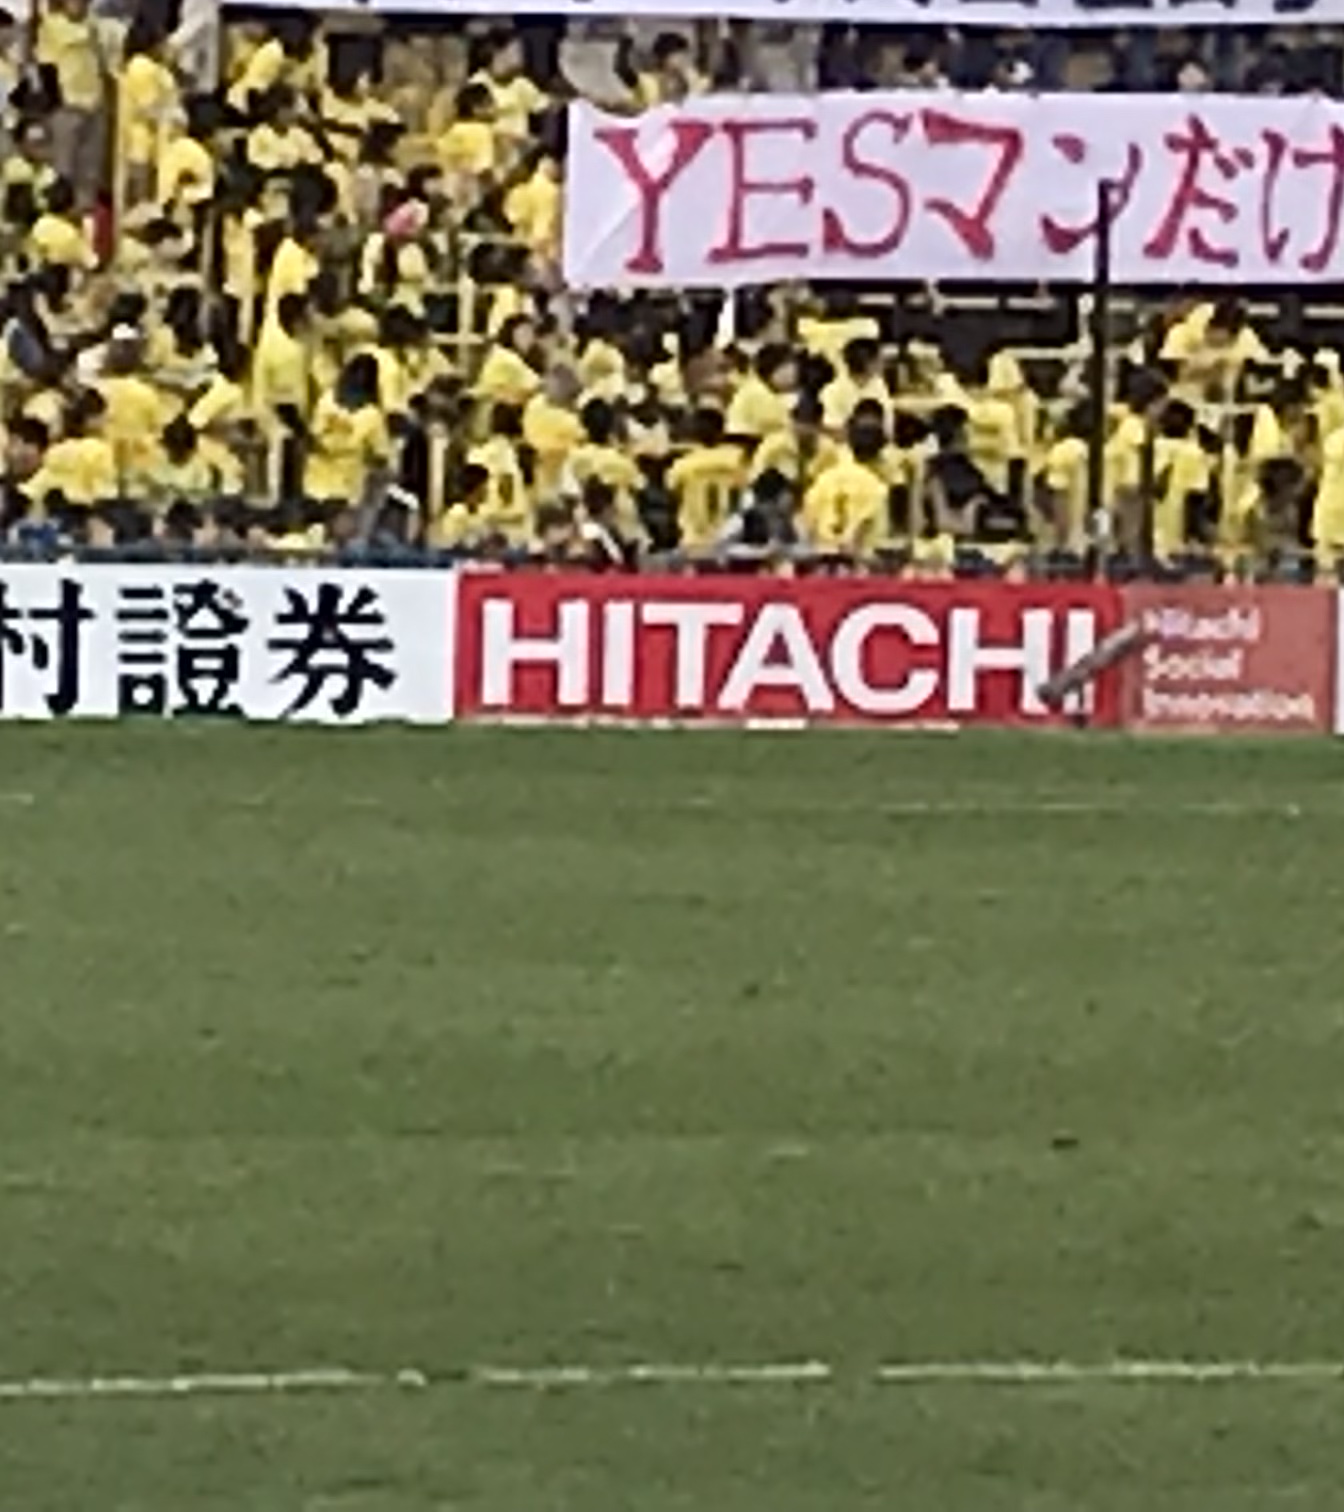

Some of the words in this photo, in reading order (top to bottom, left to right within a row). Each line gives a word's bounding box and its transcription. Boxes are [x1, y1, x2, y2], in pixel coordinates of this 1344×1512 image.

[1141, 606, 1262, 642] Hitachi
[480, 598, 1096, 716] HITACHI
[1141, 644, 1245, 680] Social
